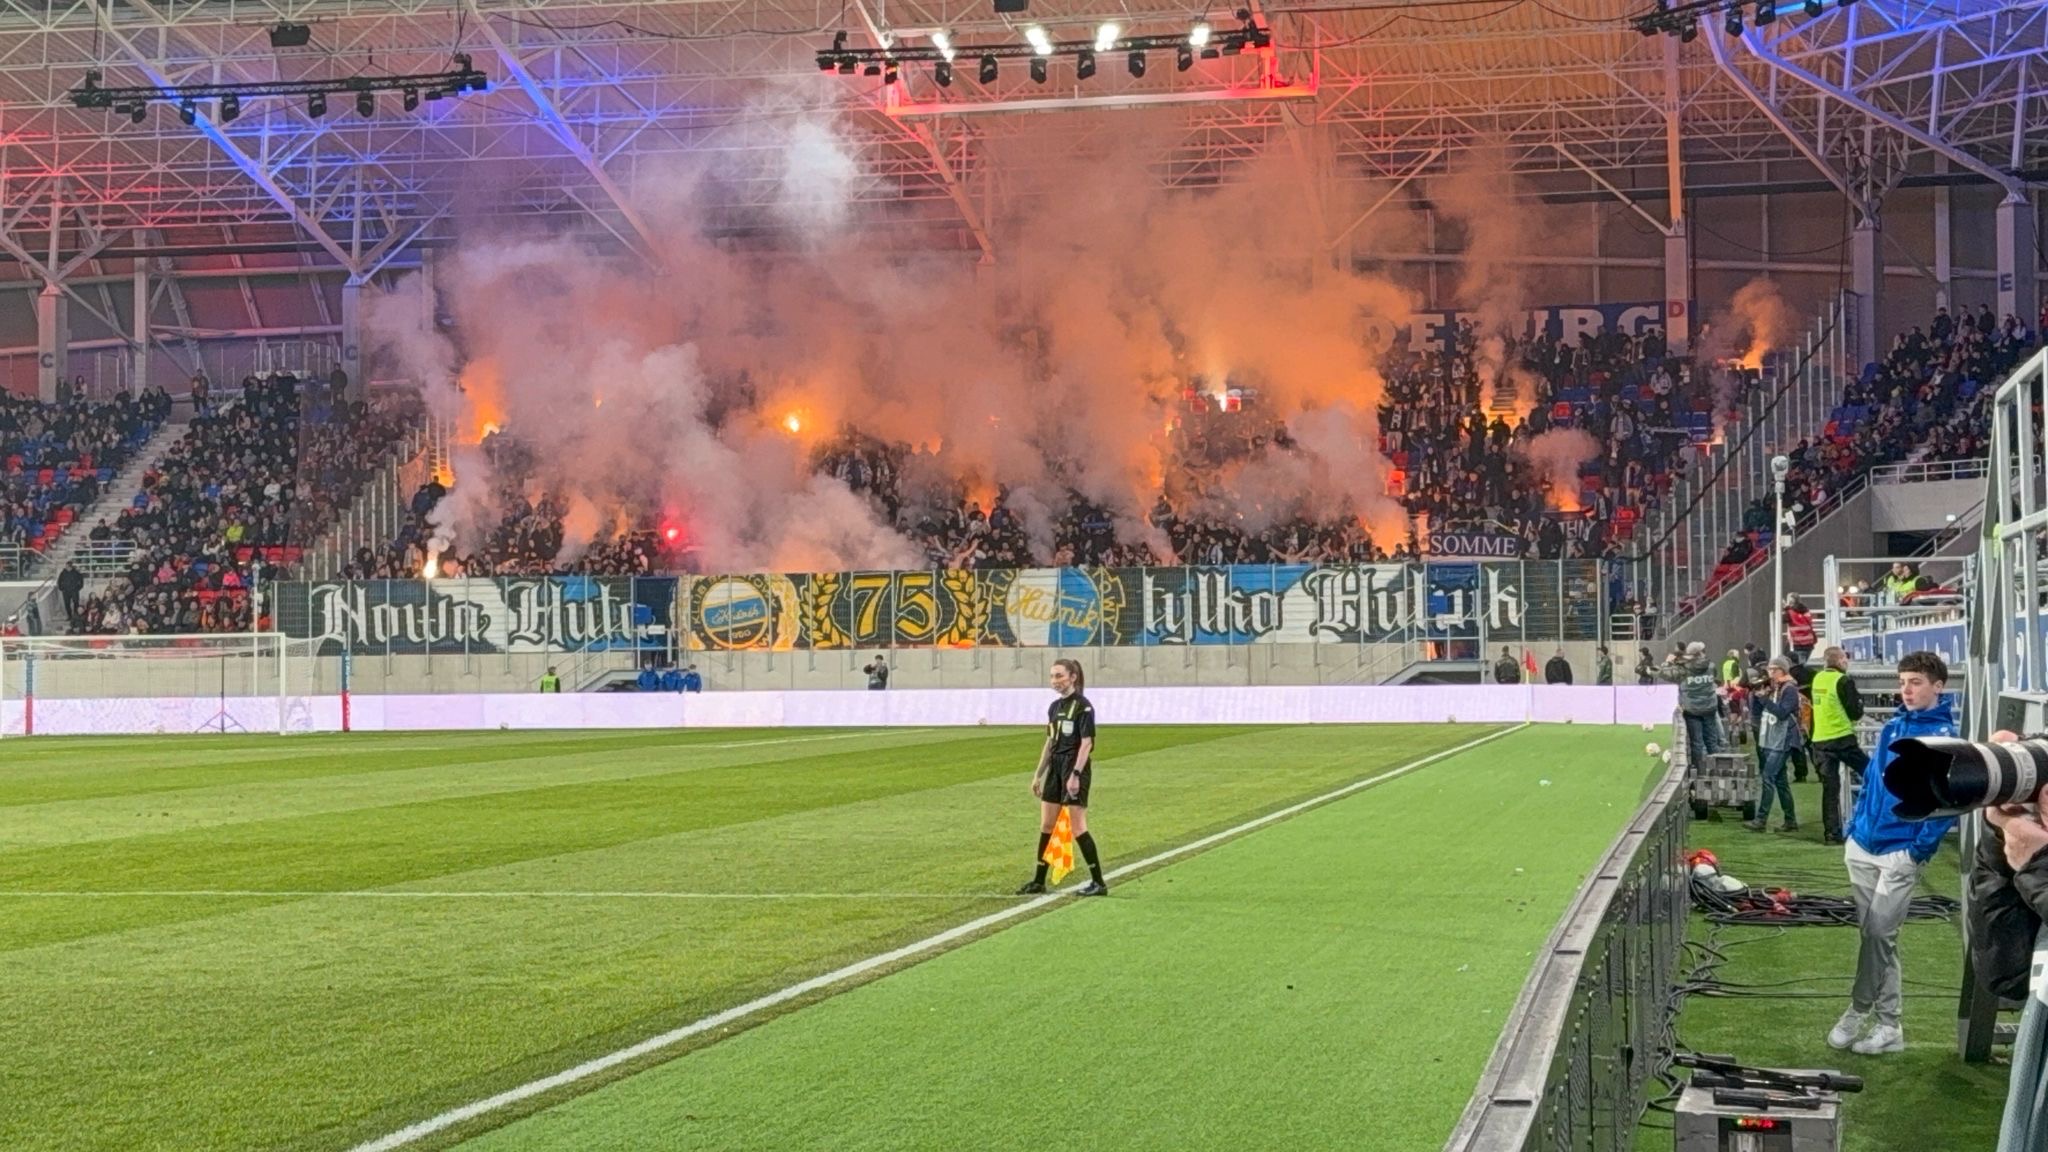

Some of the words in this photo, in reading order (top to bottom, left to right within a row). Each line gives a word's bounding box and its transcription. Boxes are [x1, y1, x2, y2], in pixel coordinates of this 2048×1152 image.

[2000, 273, 2012, 292] E
[1668, 301, 1685, 318] D
[40, 352, 54, 369] C
[1430, 535, 1517, 556] SOMME
[311, 582, 490, 646] Nowa
[851, 573, 938, 639] 75
